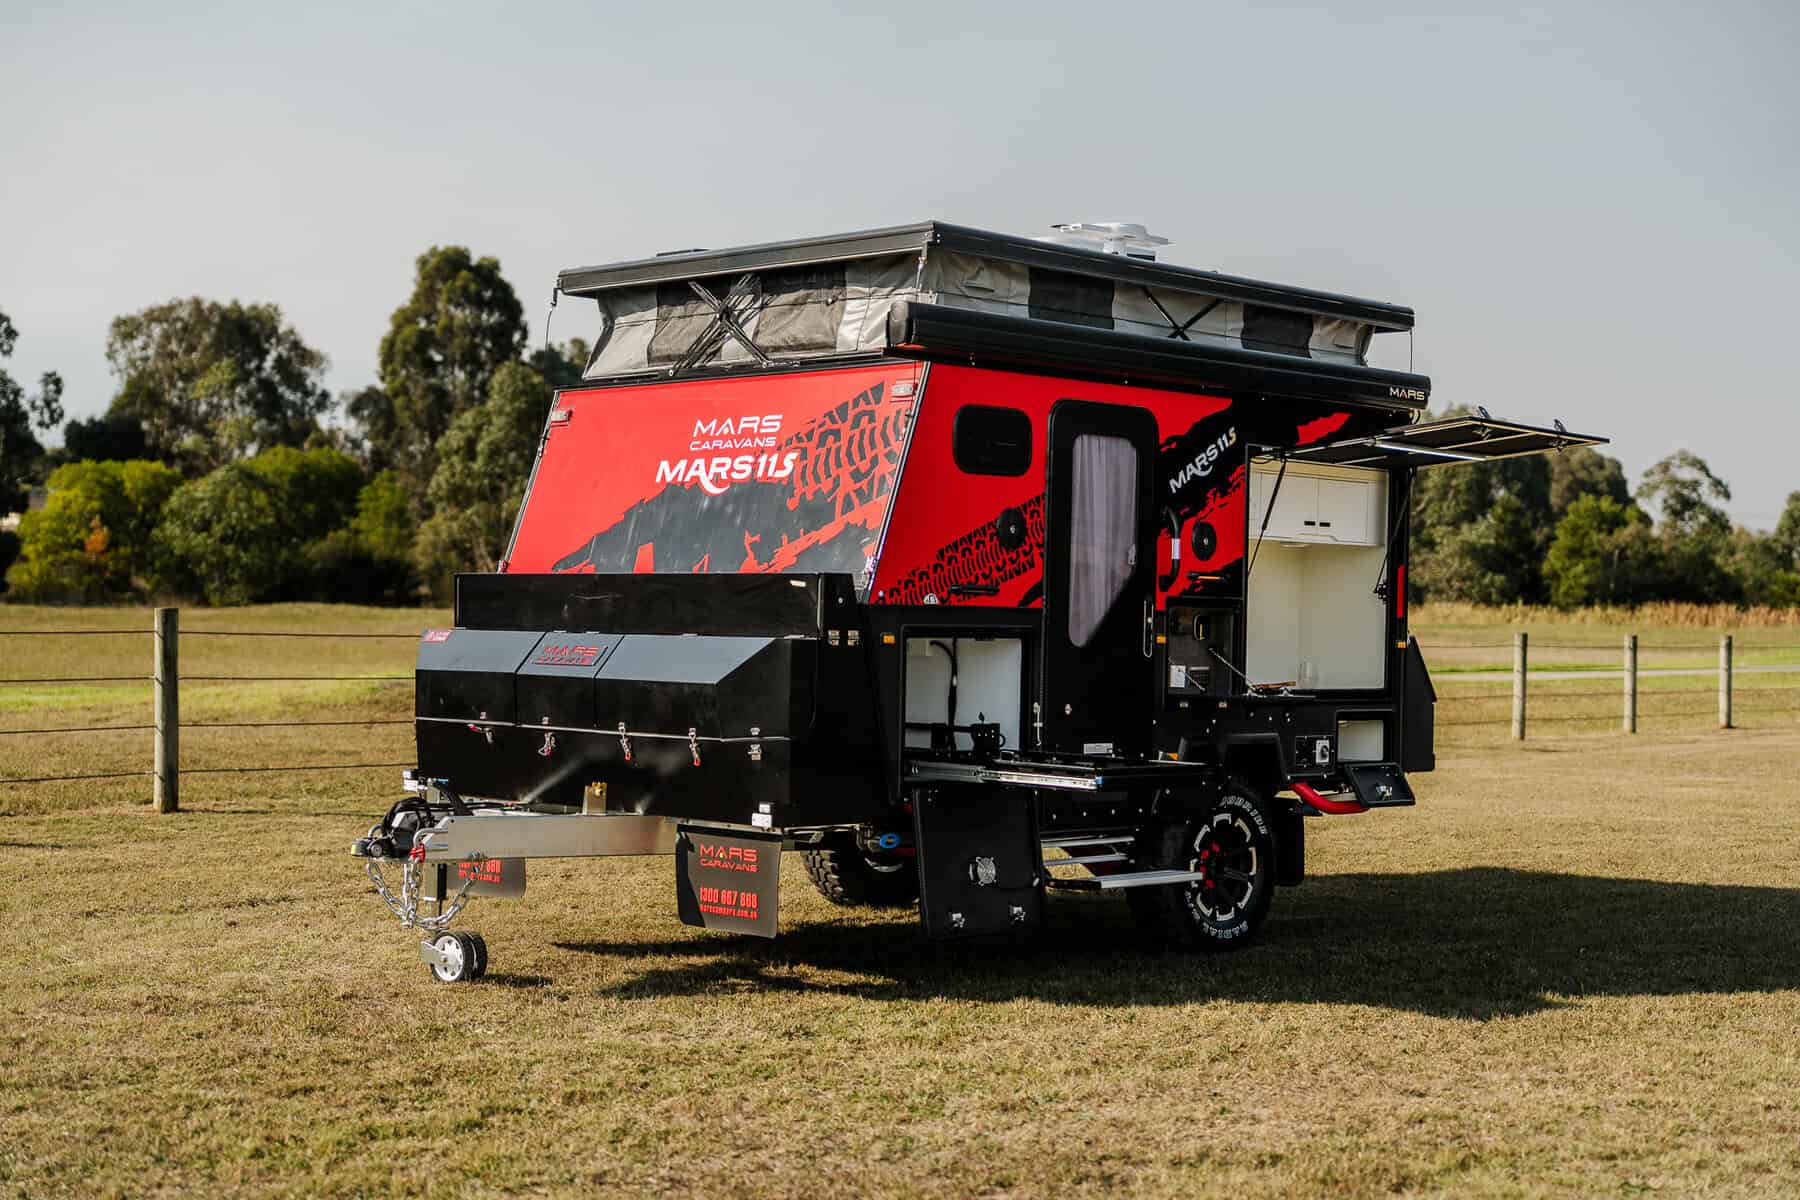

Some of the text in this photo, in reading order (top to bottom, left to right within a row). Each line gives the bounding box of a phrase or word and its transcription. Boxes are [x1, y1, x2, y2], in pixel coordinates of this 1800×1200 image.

[1390, 386, 1425, 401] MARS
[692, 414, 783, 437] MARS
[689, 436, 777, 451] CARAVANS
[699, 844, 758, 862] MARS
[699, 858, 759, 873] CARAVANS
[700, 886, 719, 903] 1300
